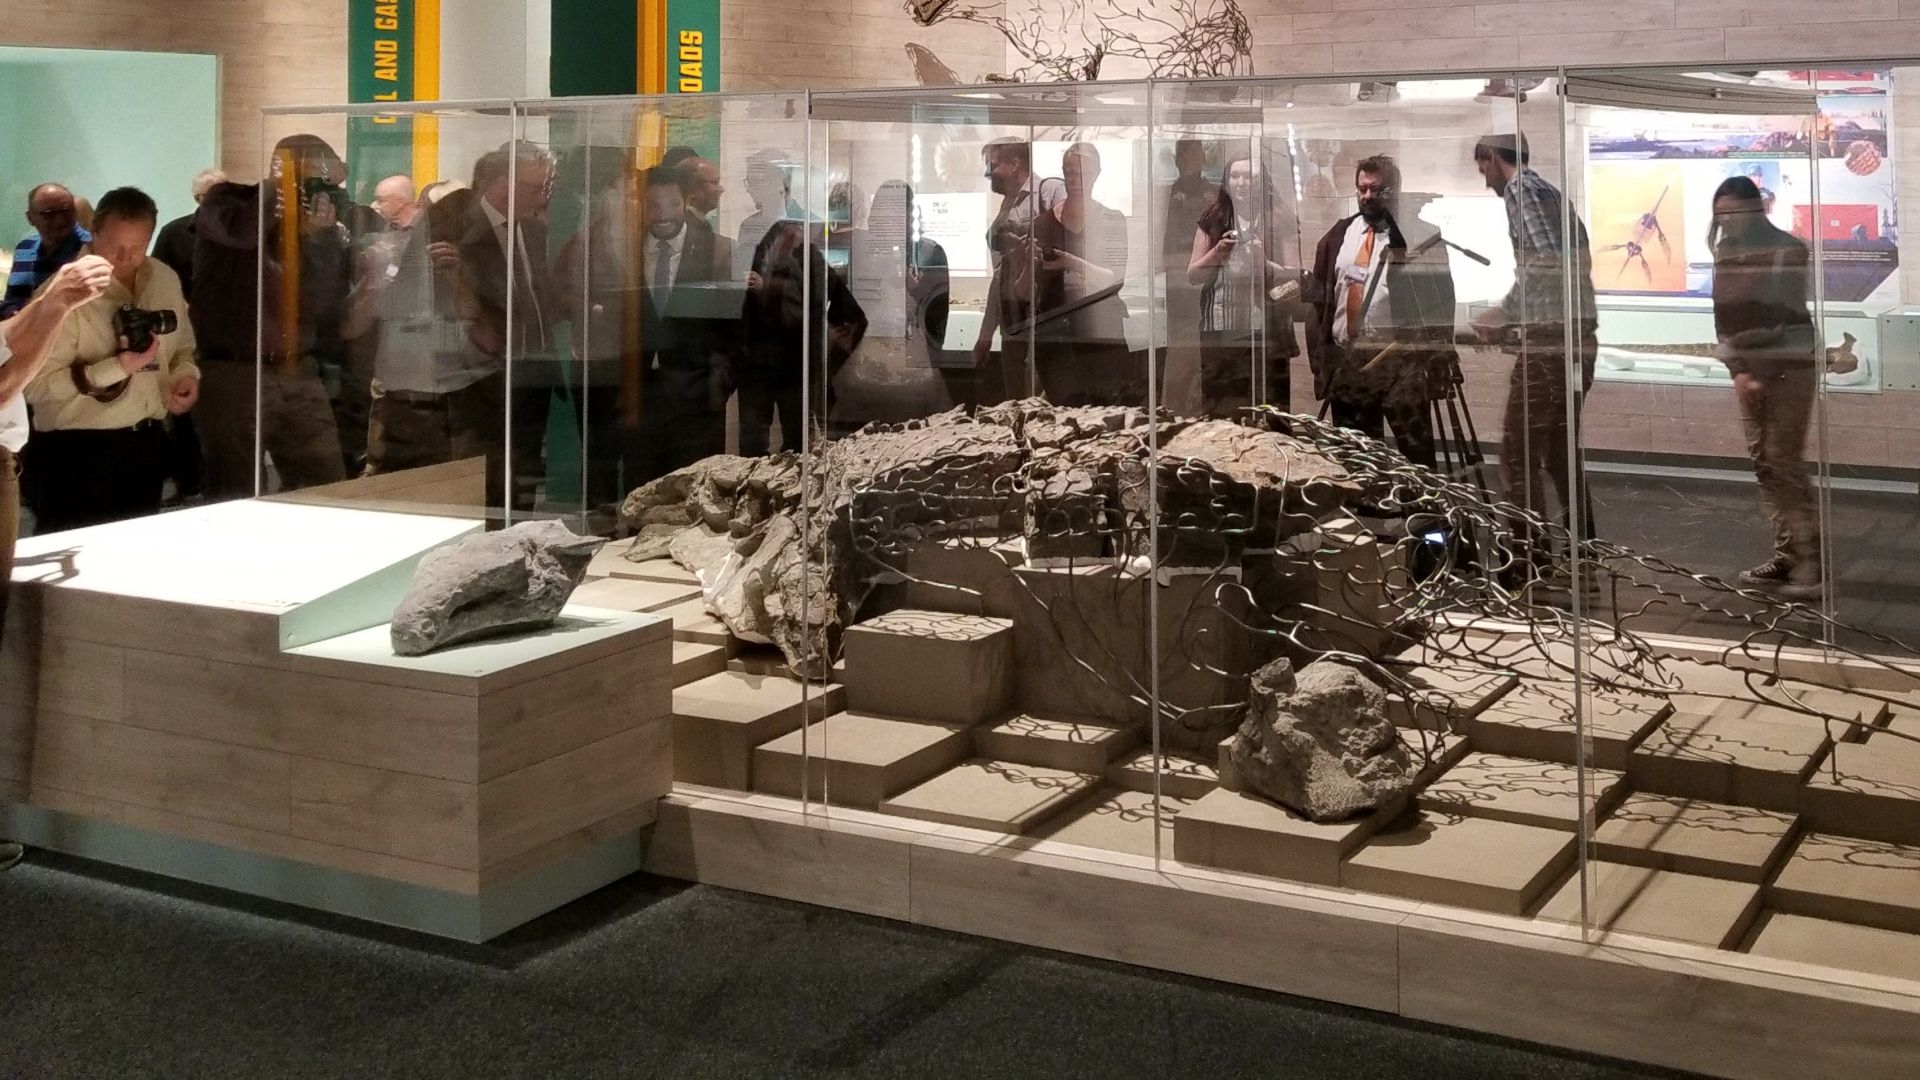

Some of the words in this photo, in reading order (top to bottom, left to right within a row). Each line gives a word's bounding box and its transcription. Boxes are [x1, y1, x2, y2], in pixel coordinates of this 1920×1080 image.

[374, 0, 398, 30] GA
[374, 40, 398, 81] AND
[679, 30, 703, 93] OADS
